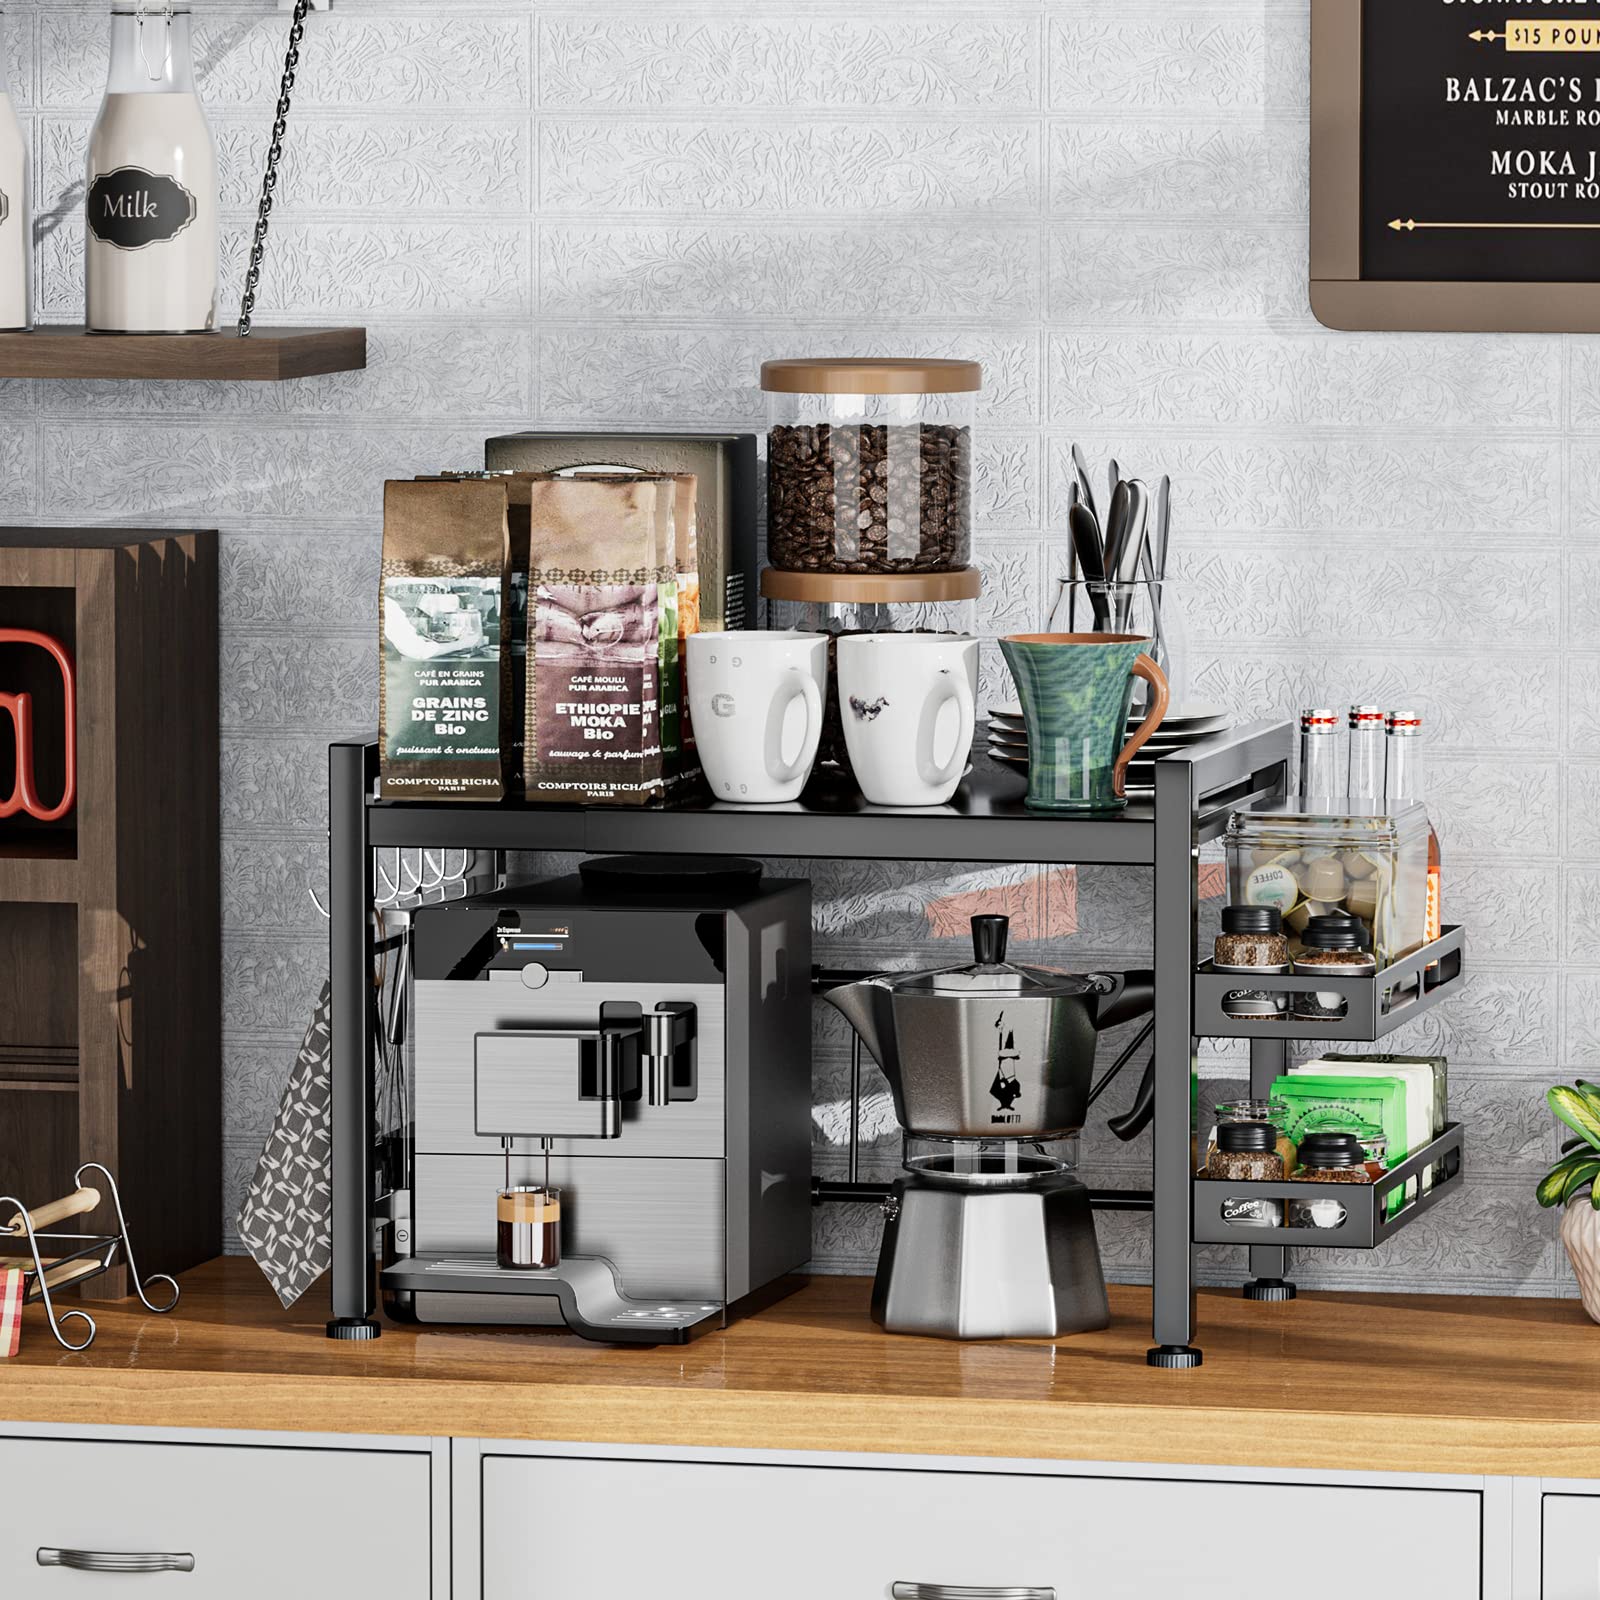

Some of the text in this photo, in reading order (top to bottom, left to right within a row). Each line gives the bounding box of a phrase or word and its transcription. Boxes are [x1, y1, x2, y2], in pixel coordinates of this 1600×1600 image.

[1515, 28, 1541, 44] $15
[1446, 76, 1582, 103] BALZAC'S
[1496, 109, 1600, 126] MARBLE RO
[1490, 150, 1576, 176] MOKA
[1508, 182, 1600, 199] STOUT RO
[103, 190, 159, 218] Milk
[414, 669, 485, 678] CAFÉ EN GRAINS
[570, 675, 626, 684] CAFÉ MOULU
[420, 679, 482, 687] PUR ARABICA
[568, 684, 629, 692] PUR ARABICA
[412, 697, 487, 709] GRAINS
[555, 702, 641, 715] ETHIOPIE
[711, 693, 736, 718] G
[411, 709, 489, 721] DE ZINC
[570, 715, 627, 728] MOKA
[434, 723, 466, 735] Bio
[583, 728, 615, 740] Bio
[396, 745, 442, 755] puissant
[444, 745, 454, 754] &
[592, 749, 602, 758] &
[386, 777, 459, 786] COMPTOIRS
[537, 782, 608, 791] COMPTOIRS
[1253, 870, 1284, 885] COFFEE
[1224, 1201, 1260, 1218] Coffee
